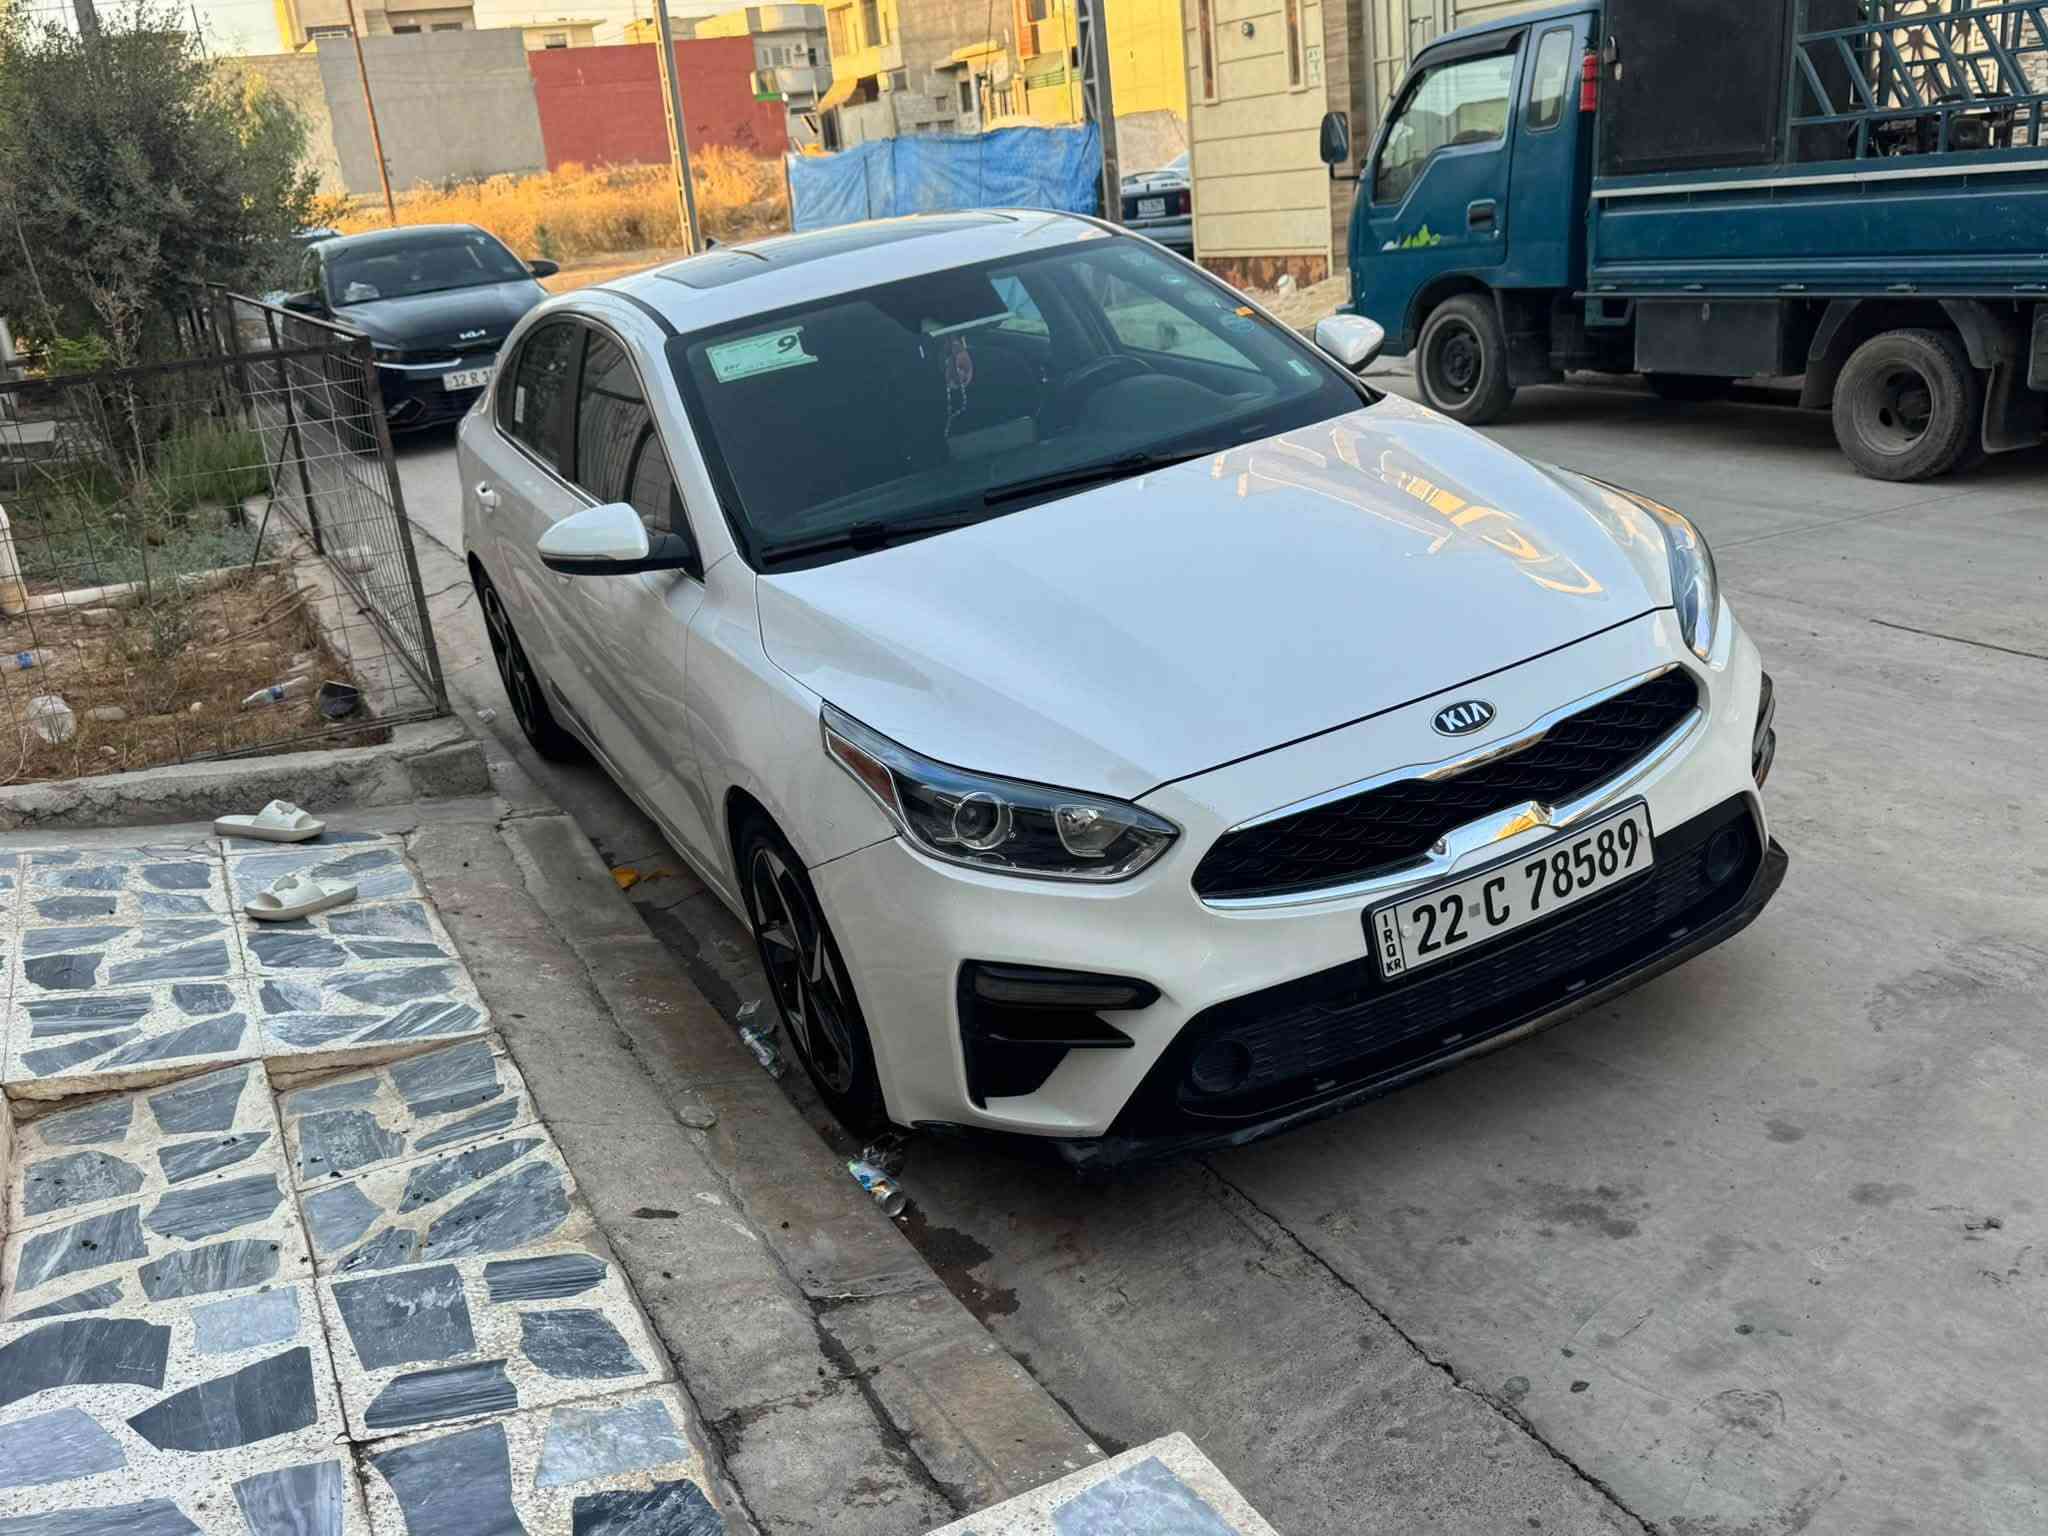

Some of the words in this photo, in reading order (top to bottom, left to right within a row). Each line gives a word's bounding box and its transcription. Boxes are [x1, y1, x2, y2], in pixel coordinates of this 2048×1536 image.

[1440, 702, 1490, 731] KIA
[1412, 893, 1468, 955] 22
[1483, 877, 1510, 926] C
[1525, 818, 1639, 911] 78589
[1386, 958, 1402, 973] KR
